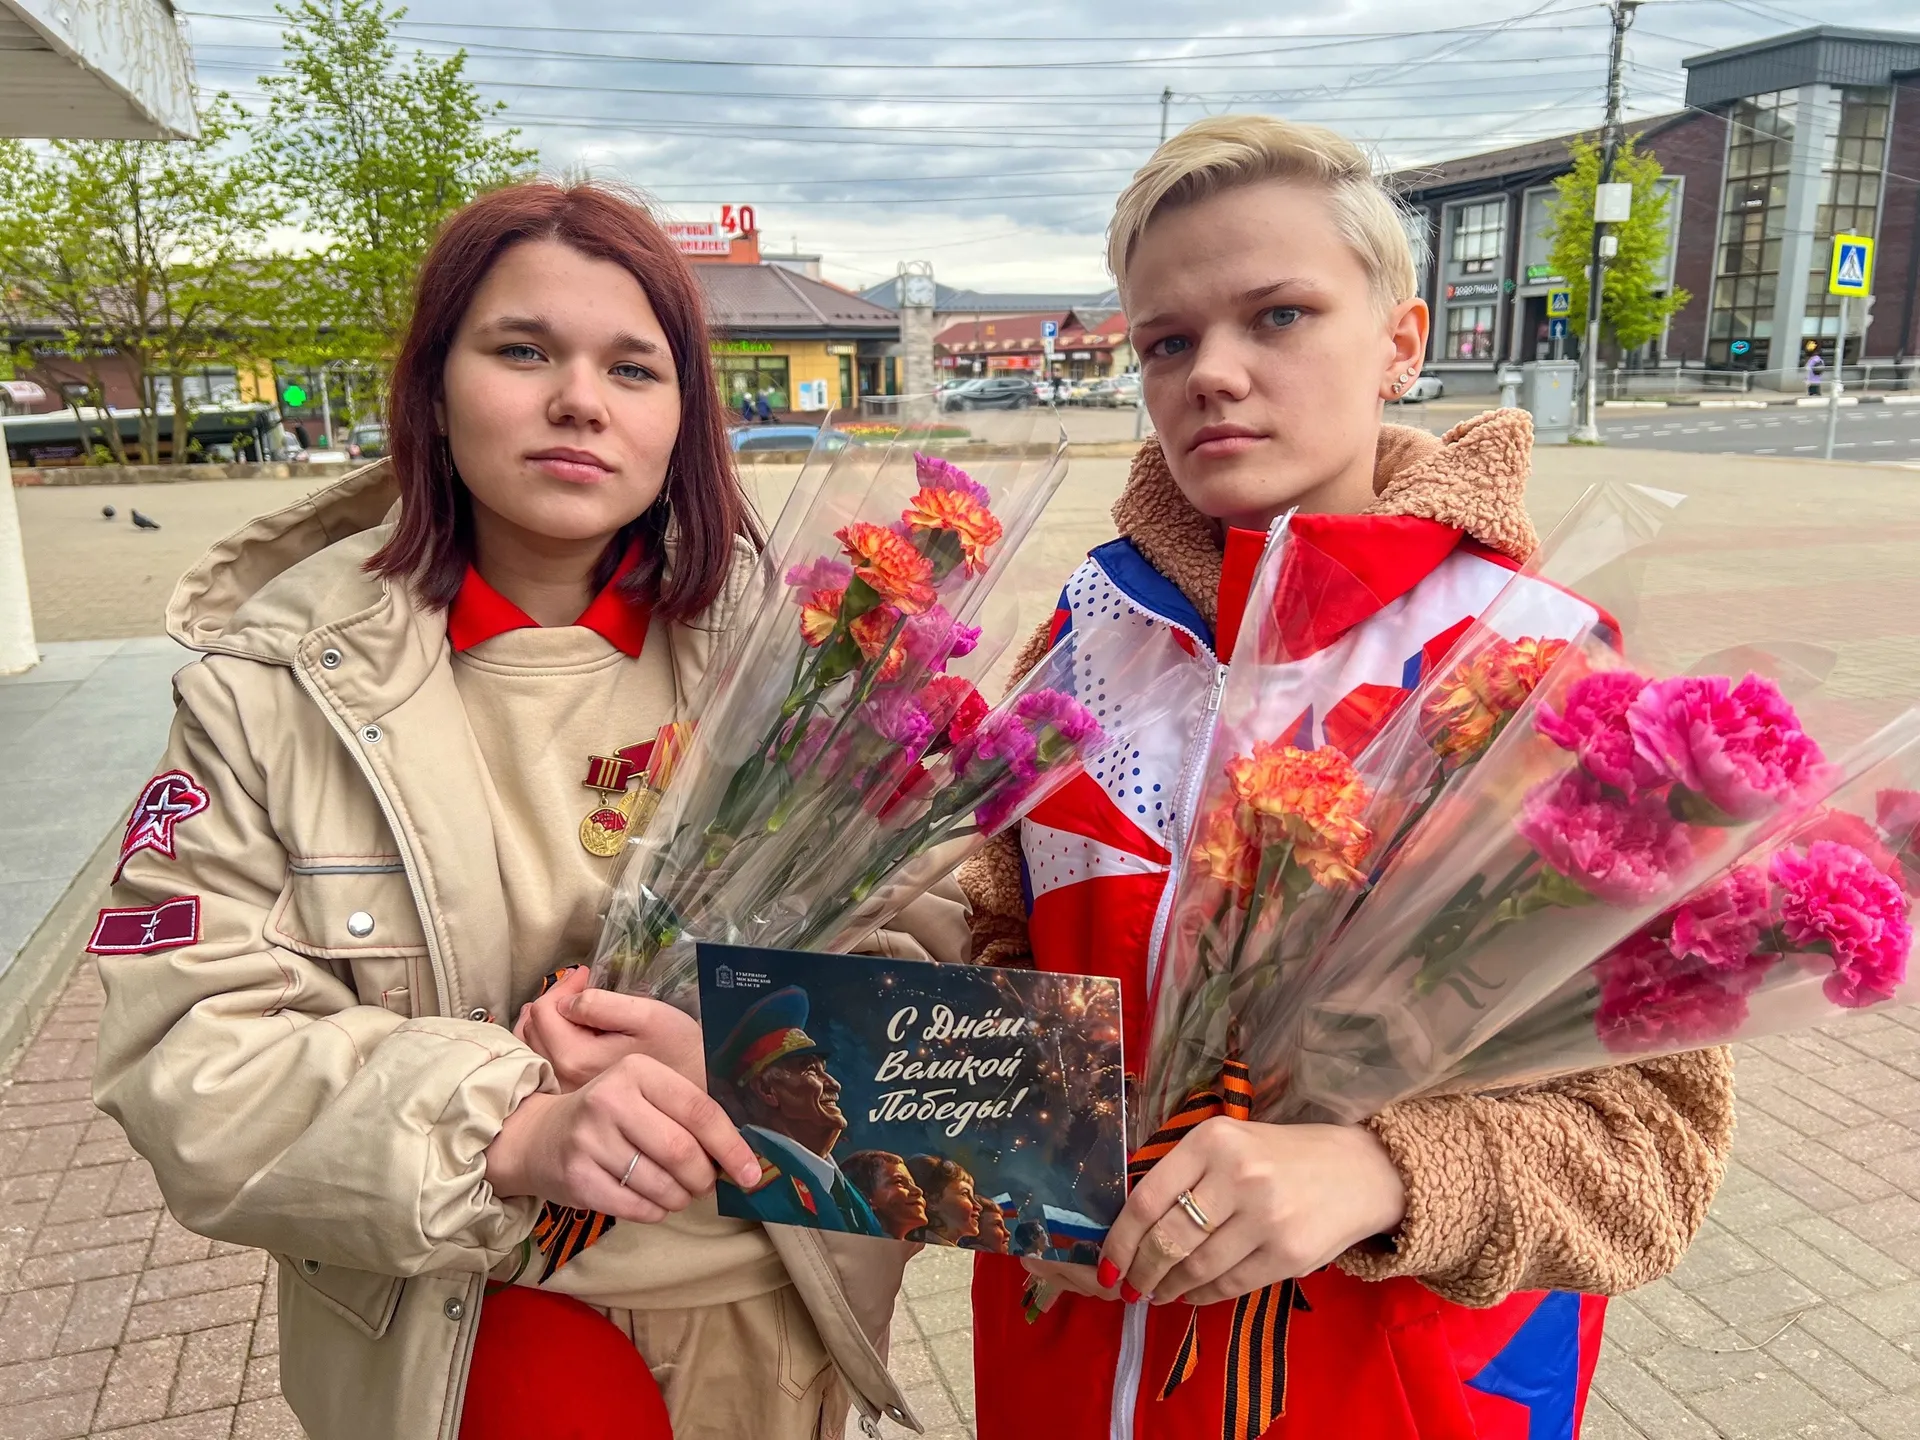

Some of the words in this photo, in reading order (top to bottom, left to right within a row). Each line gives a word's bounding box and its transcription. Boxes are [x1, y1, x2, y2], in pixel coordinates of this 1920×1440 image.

[721, 205, 754, 235] 40
[886, 1005, 919, 1043] С
[922, 1003, 1026, 1041] Днём
[874, 1047, 1024, 1086] Великой
[868, 1086, 1029, 1138] Победы!
